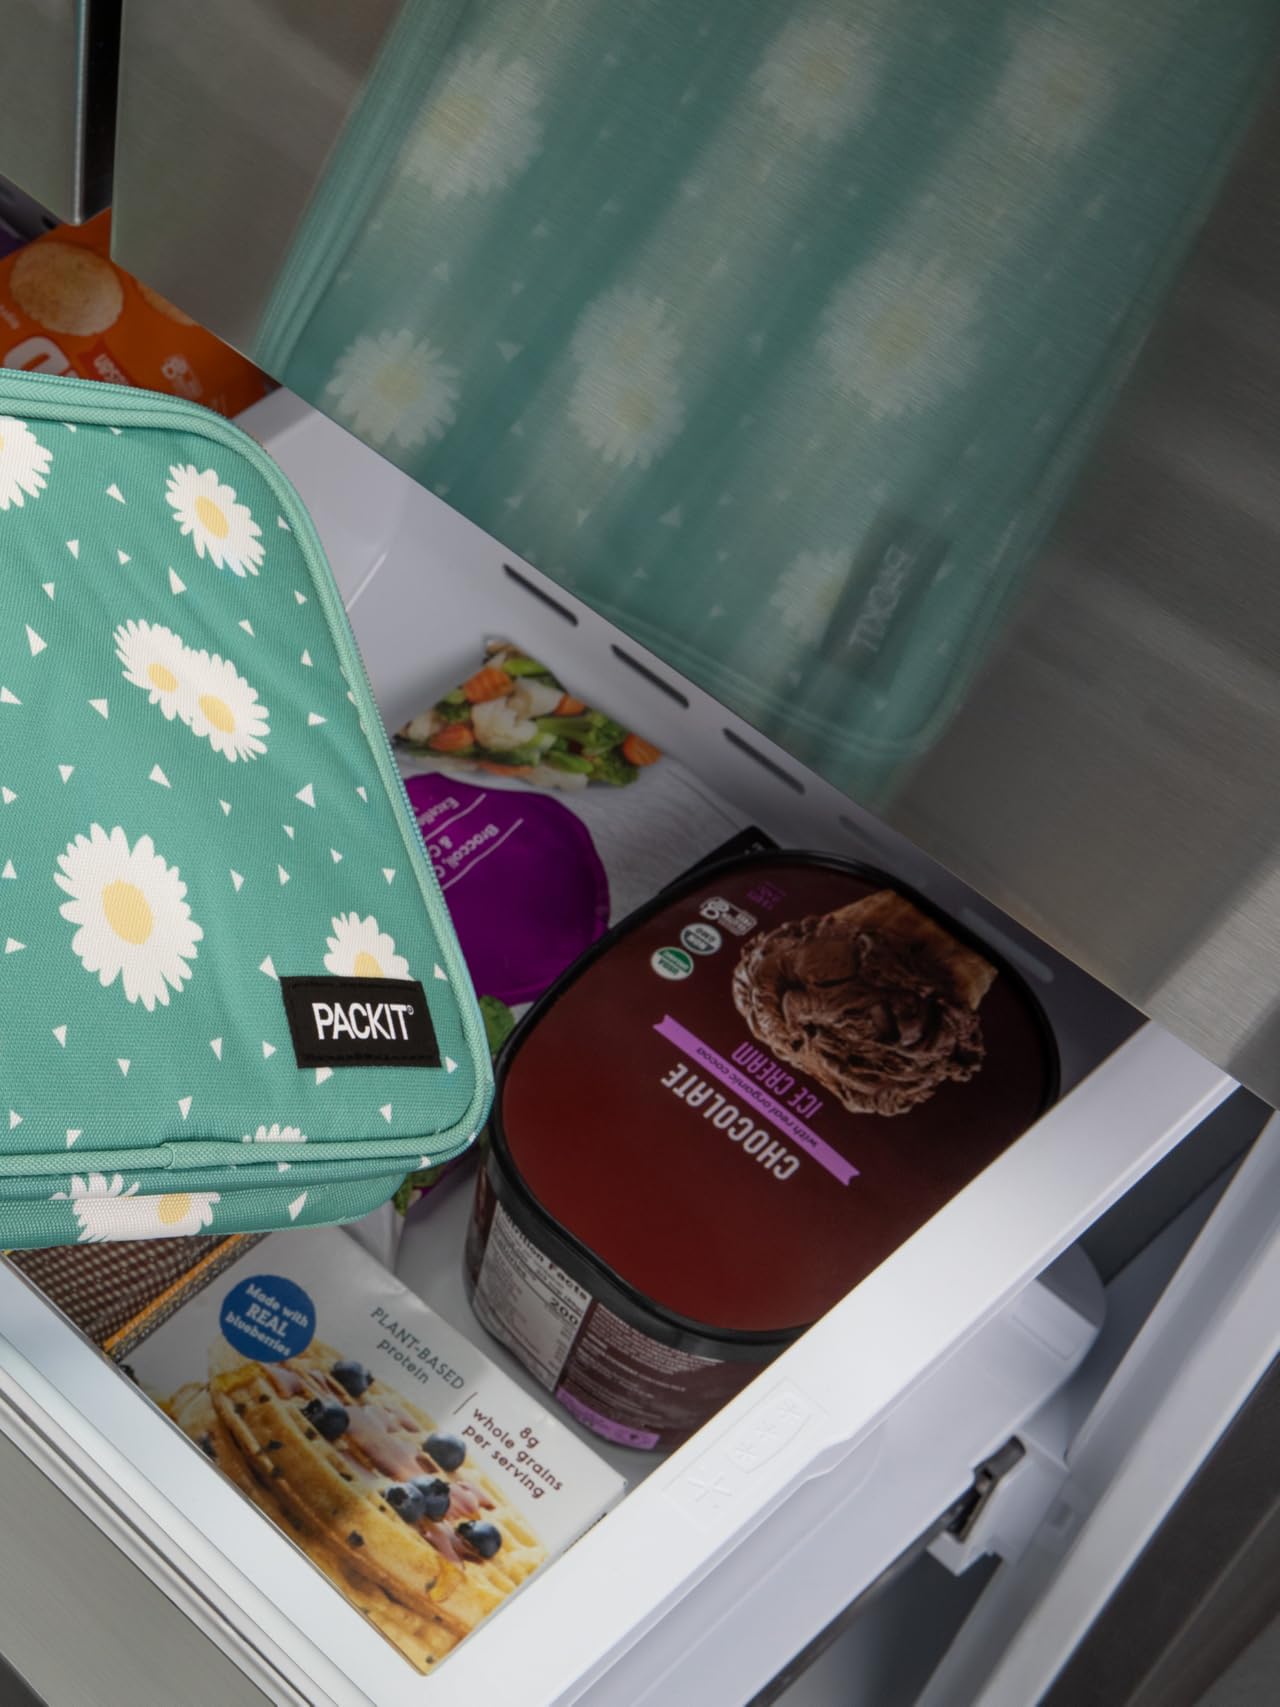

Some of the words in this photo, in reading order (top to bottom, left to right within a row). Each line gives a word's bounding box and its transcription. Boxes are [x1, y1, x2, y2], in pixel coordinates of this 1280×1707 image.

[696, 1047, 730, 1075] cocoa
[731, 1040, 796, 1097] CREAM
[728, 1073, 772, 1110] organic
[786, 1086, 824, 1120] ICE
[660, 1062, 801, 1181] CHOCOLATE
[769, 1106, 796, 1129] real
[793, 1124, 818, 1148] with
[245, 1283, 281, 1311] Made
[283, 1305, 308, 1329] with
[245, 1302, 289, 1338] REAL
[225, 1311, 291, 1357] blueberries
[370, 1306, 466, 1392] PLANT-BASED
[376, 1338, 430, 1386] protein
[473, 1407, 515, 1449] whole
[516, 1450, 564, 1491] grains
[519, 1426, 540, 1449] 8g
[461, 1424, 492, 1449] per
[491, 1450, 545, 1499] serving
